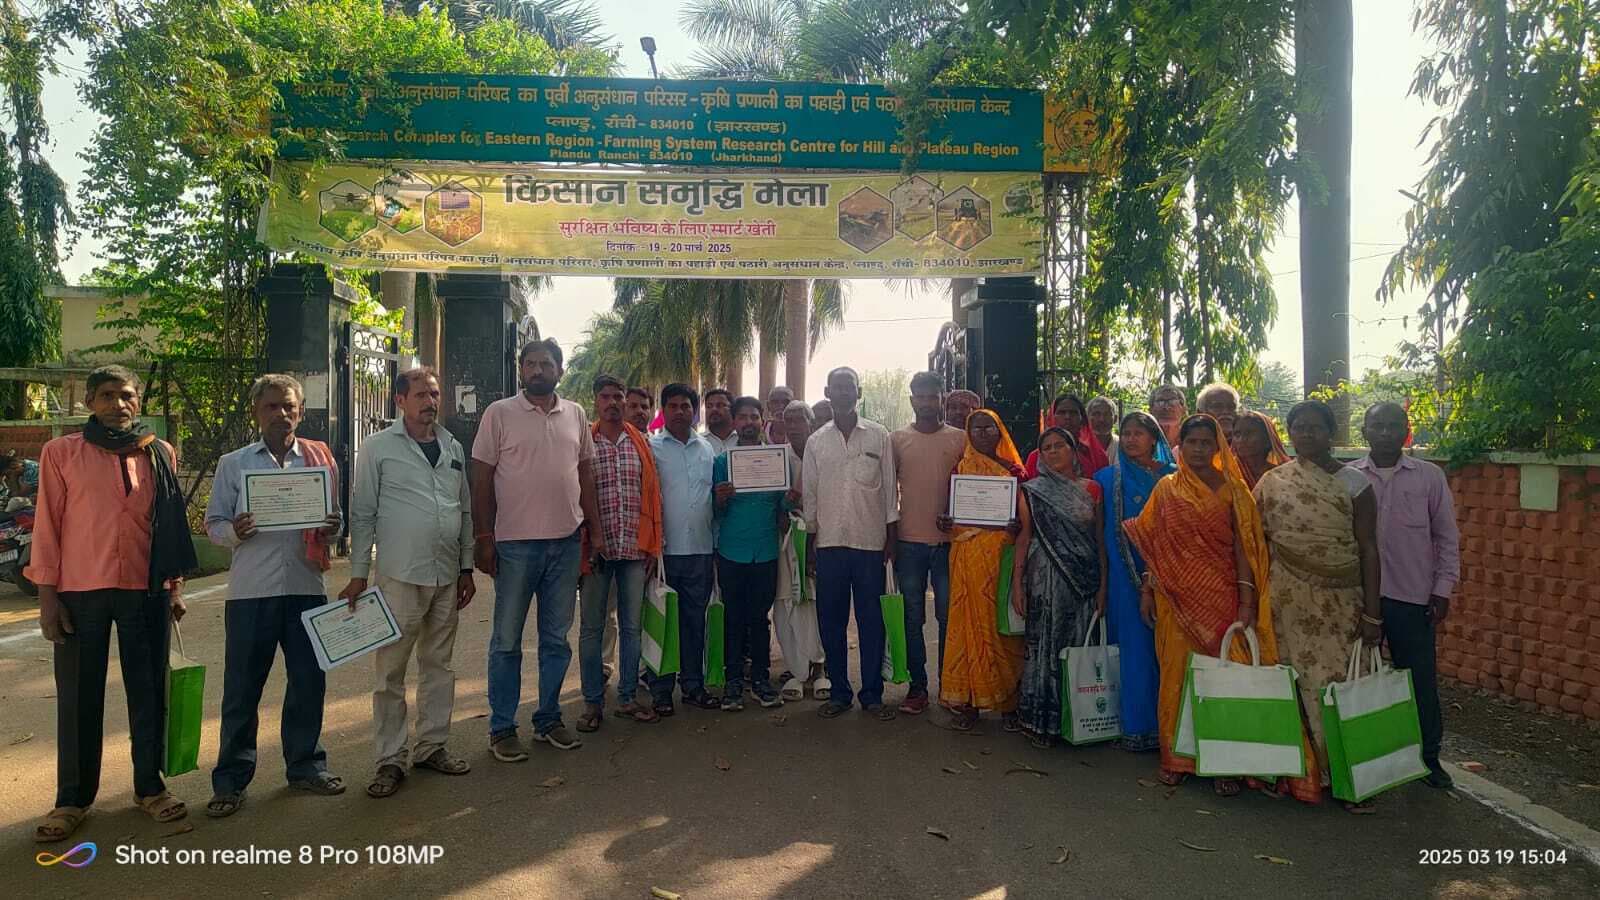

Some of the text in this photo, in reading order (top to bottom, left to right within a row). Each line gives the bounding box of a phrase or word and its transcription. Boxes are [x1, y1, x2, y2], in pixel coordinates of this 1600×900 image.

[467, 81, 510, 104] परिषद
[518, 86, 537, 103] का
[544, 82, 570, 108] पूर्वी
[574, 86, 637, 111] अनुसंधान
[736, 88, 778, 110] प्रणाली
[784, 95, 803, 109] का
[809, 90, 846, 114] पहाड़ी
[851, 93, 870, 113] एवं
[981, 95, 1011, 116] केन्द्र
[650, 119, 694, 130] 834010
[394, 129, 455, 145] Complex
[486, 132, 541, 145] Eastern
[546, 132, 594, 149] Region
[666, 136, 717, 154] System
[722, 137, 785, 152] Research
[791, 140, 836, 153] Centre
[840, 140, 859, 152] for
[863, 140, 885, 153] Hill
[974, 142, 1019, 158] Region
[550, 149, 591, 159] Plandu
[649, 151, 693, 161] 834010
[711, 153, 782, 164] (Jharkhand)
[503, 175, 829, 216] किसान समृद्धि मेला
[559, 219, 777, 239] सुरक्षित भविष्य के लिए स्मार्ट खेती
[649, 243, 660, 251] 19
[671, 243, 682, 252] 20
[684, 242, 703, 252] मार्च
[708, 243, 732, 253] 2025
[668, 259, 683, 268] का
[719, 258, 736, 269] एवं
[739, 258, 768, 269] पठारी
